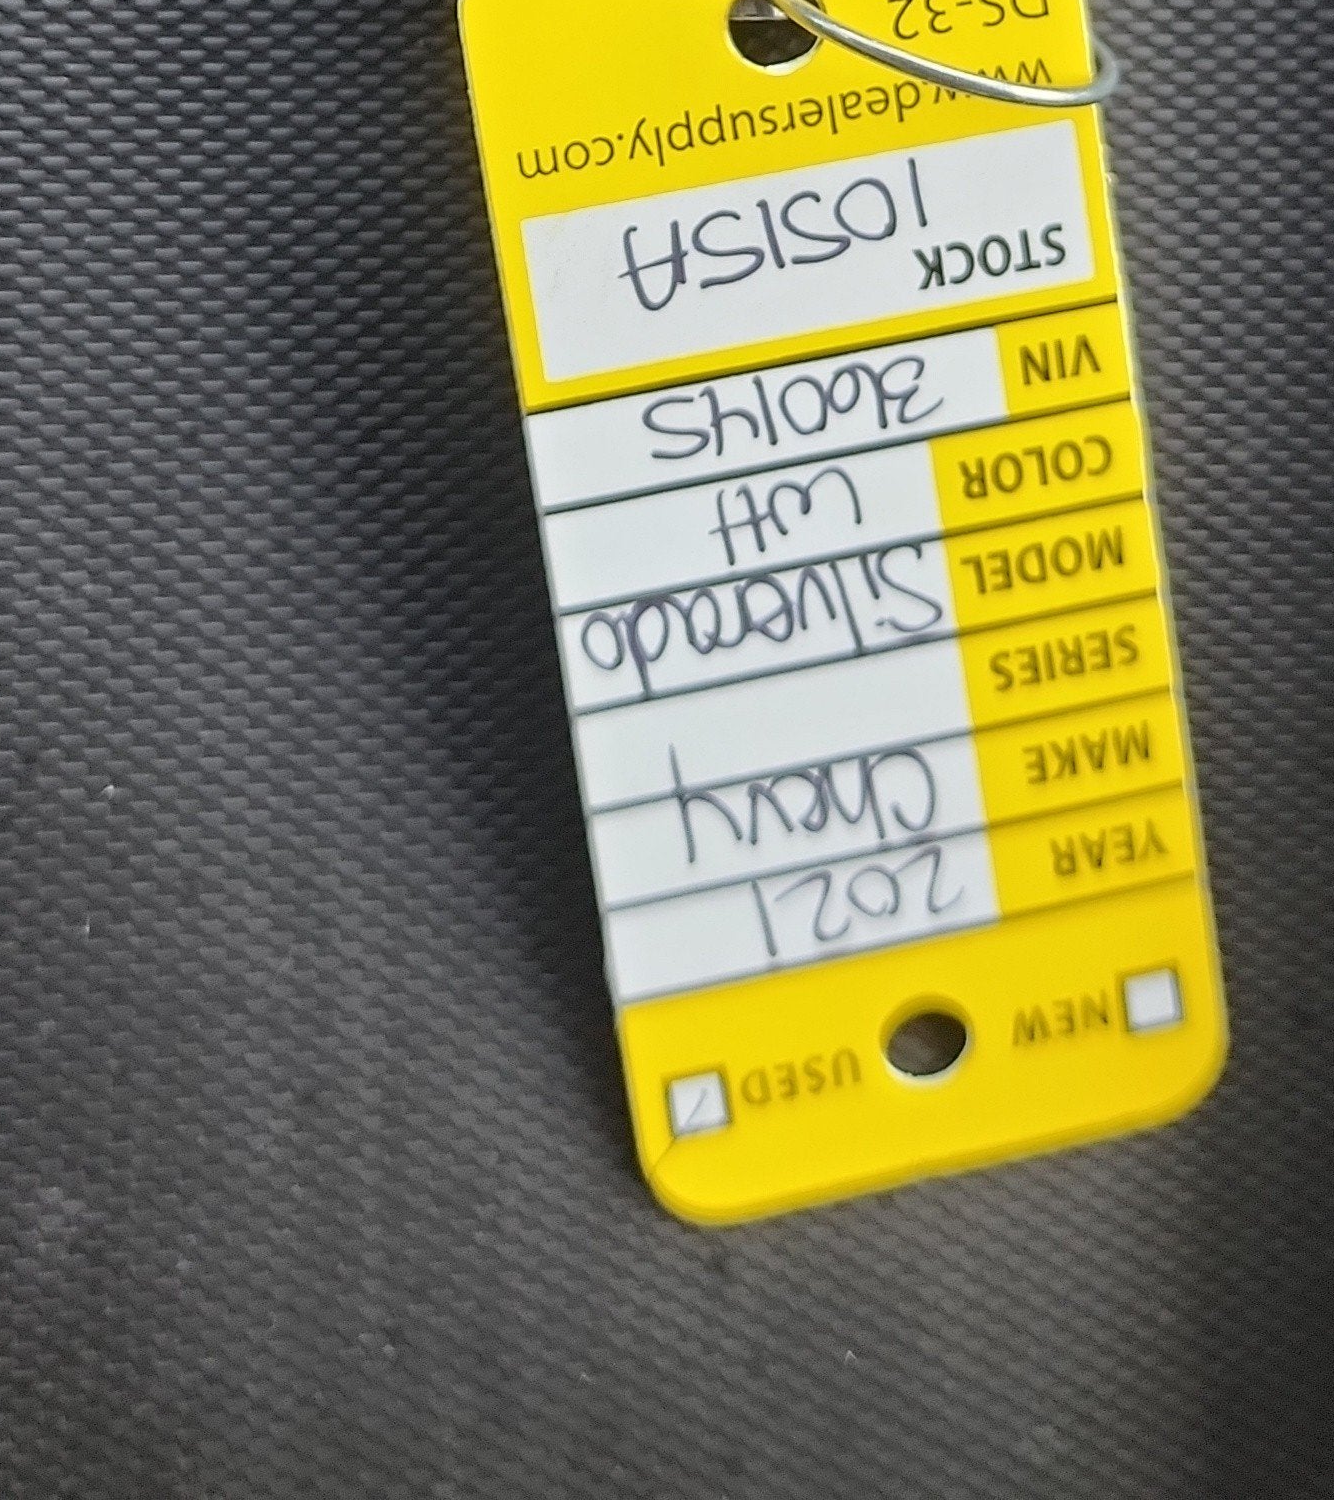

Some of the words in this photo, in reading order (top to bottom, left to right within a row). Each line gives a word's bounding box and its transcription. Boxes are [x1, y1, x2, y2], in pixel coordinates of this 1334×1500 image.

[910, 224, 1066, 289] STOCK
[1017, 333, 1101, 384] VIN
[958, 435, 1112, 499] COLOR
[959, 524, 1124, 594] MODEL
[580, 540, 941, 700] Silverado
[987, 622, 1139, 691] SERIES
[1021, 720, 1151, 785] MAKE
[667, 743, 936, 863] Chevy
[1049, 817, 1168, 876] YEAR
[748, 845, 962, 957] 2021
[1010, 989, 1111, 1047] NEW
[738, 1046, 861, 1106] USED
